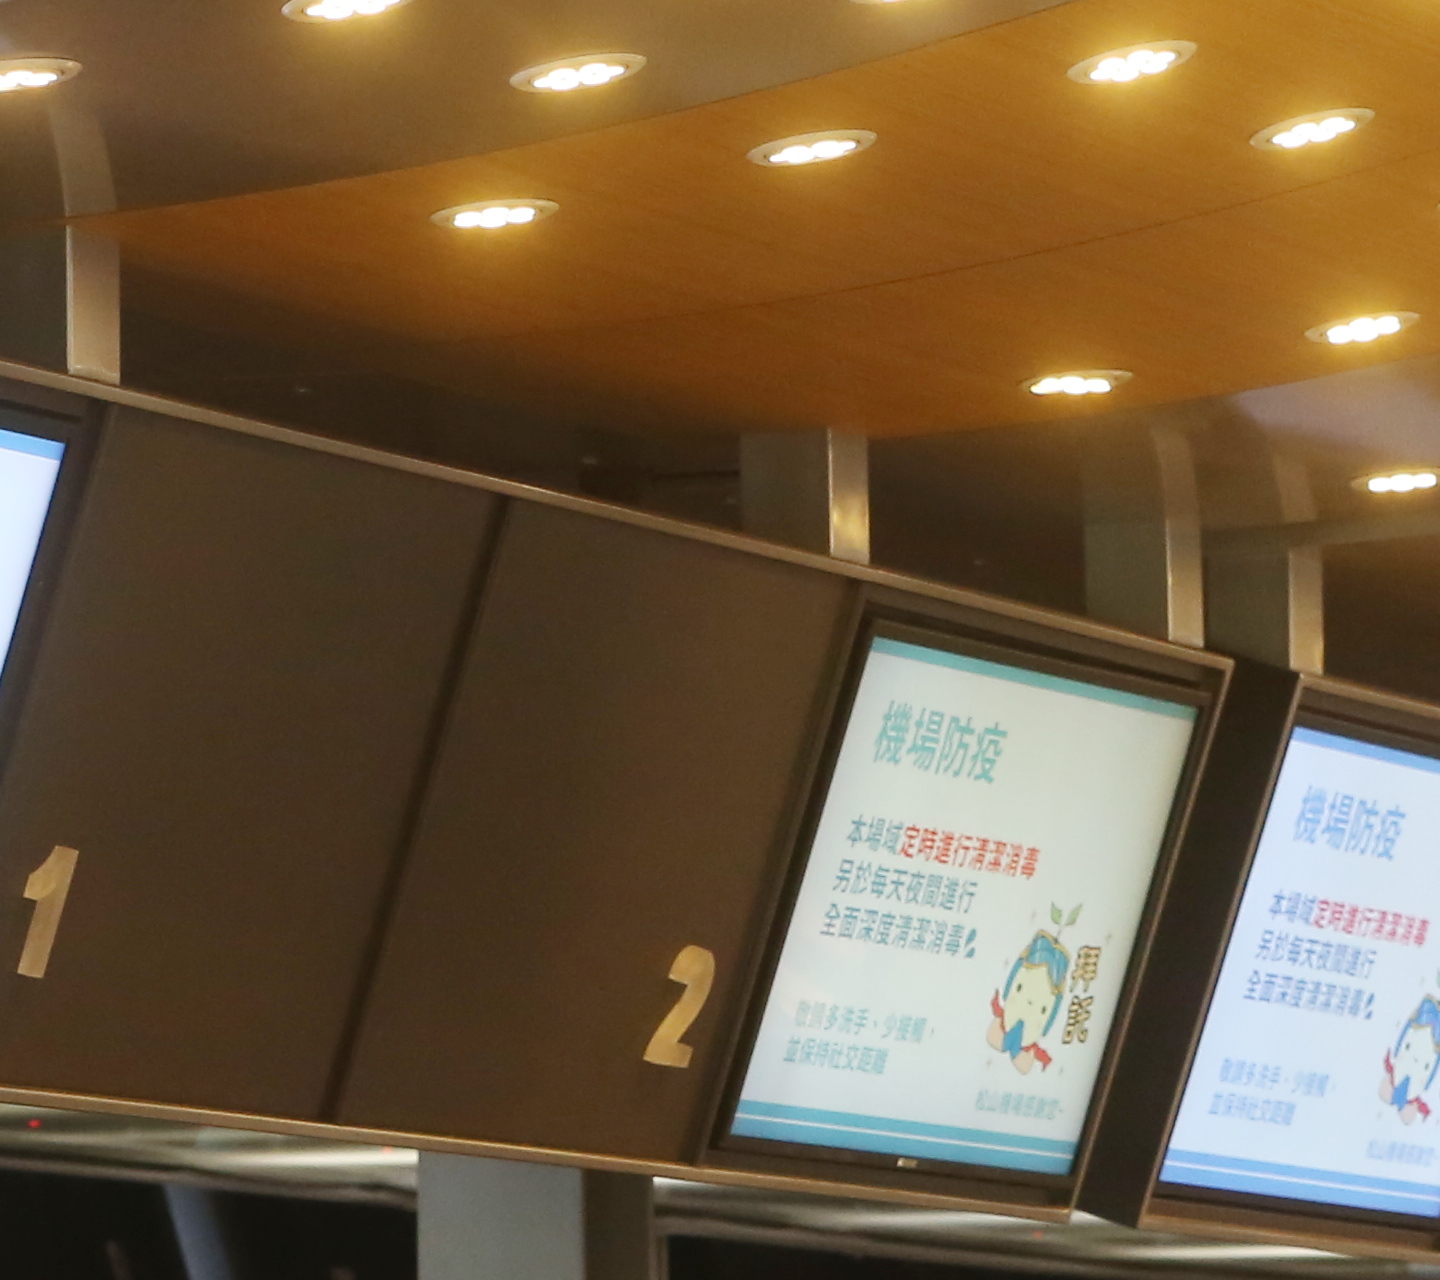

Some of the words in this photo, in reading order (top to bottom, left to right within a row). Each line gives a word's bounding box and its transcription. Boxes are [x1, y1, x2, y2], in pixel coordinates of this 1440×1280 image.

[873, 700, 1008, 784] 機場防疫
[1293, 785, 1406, 861] 機場防疫
[17, 845, 79, 978] 1
[643, 945, 715, 1068] 2
